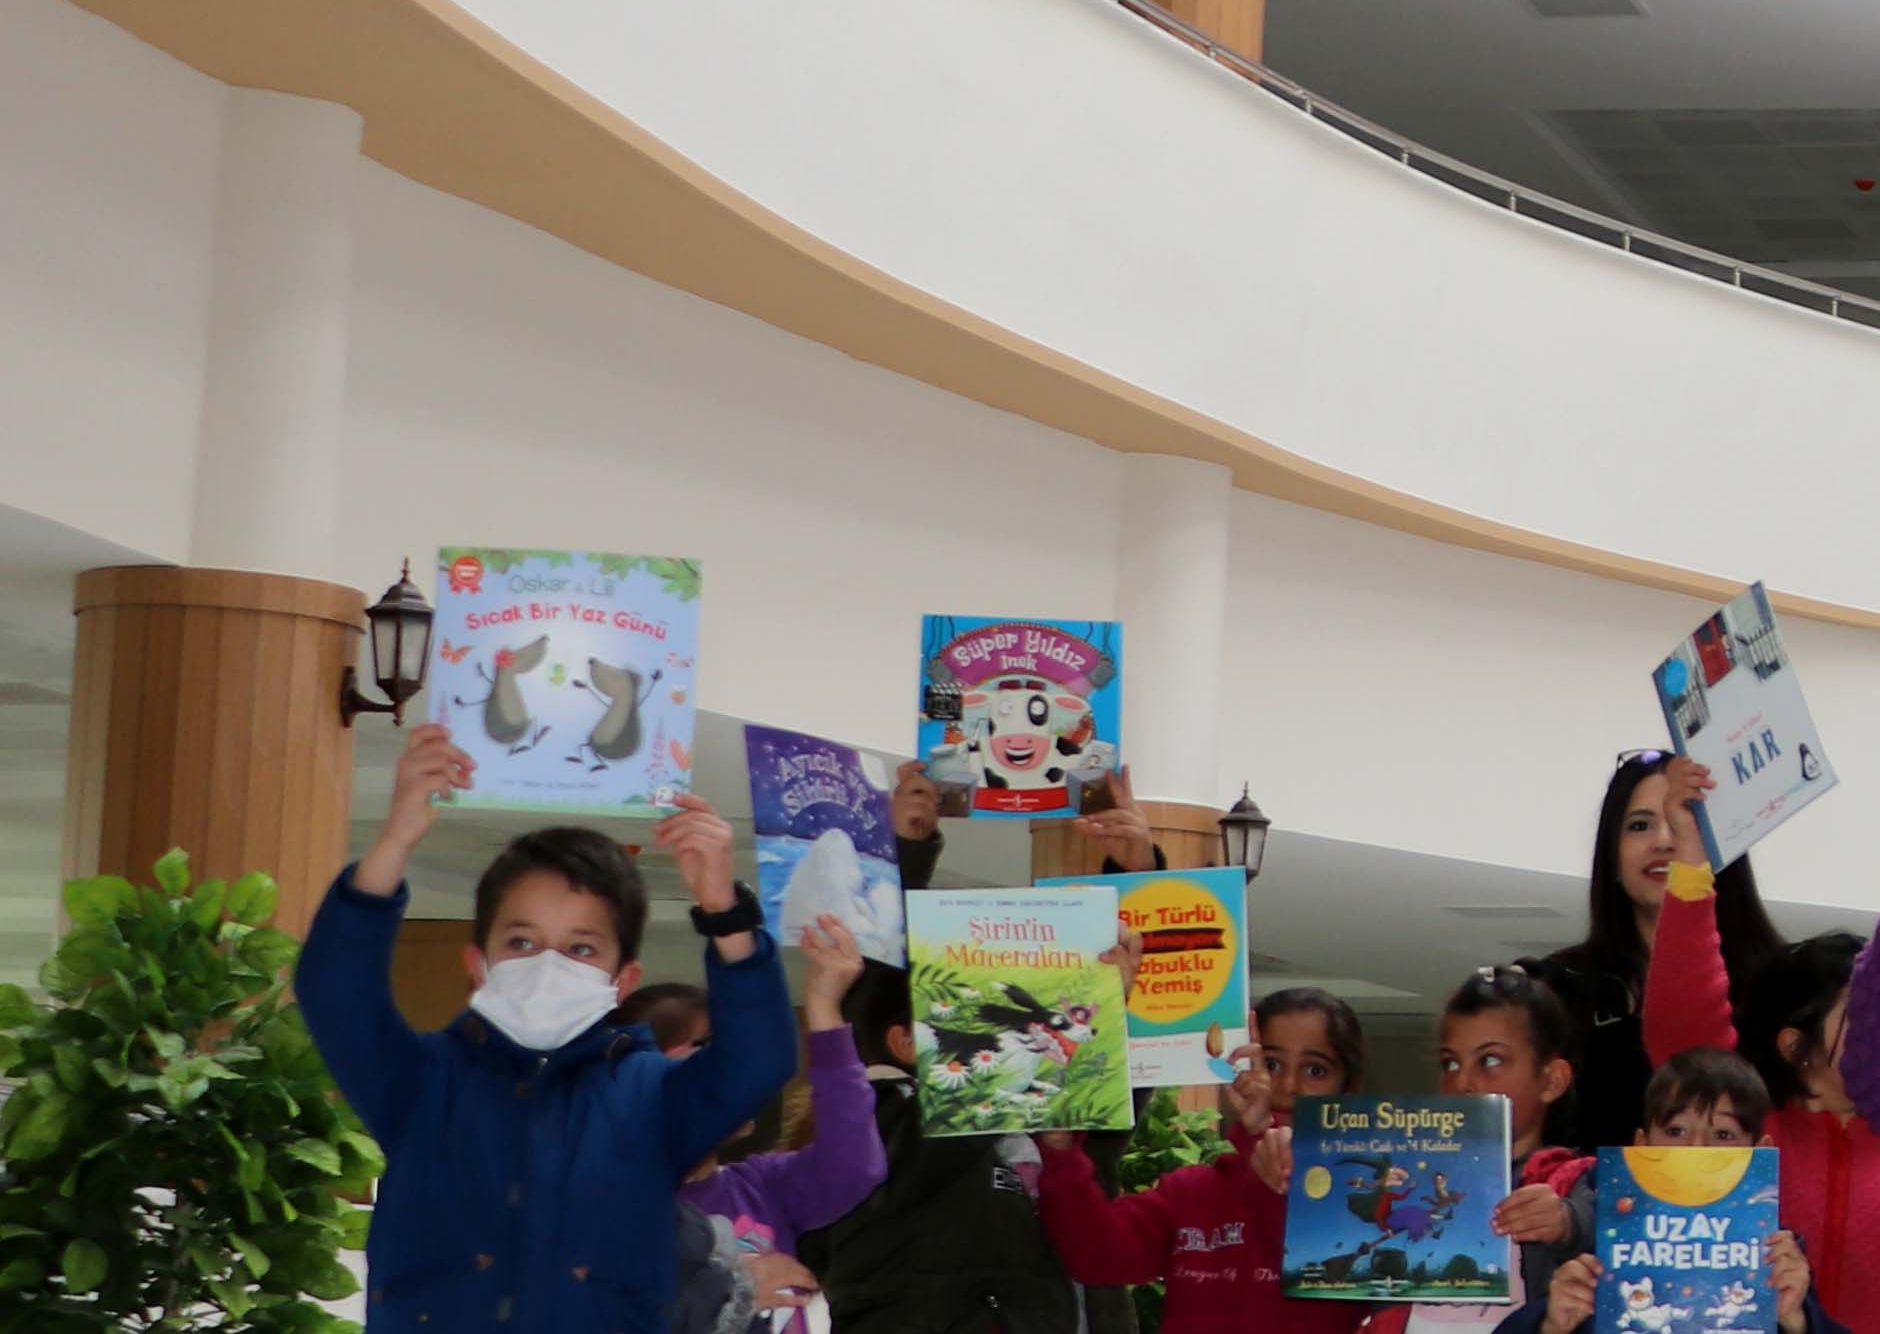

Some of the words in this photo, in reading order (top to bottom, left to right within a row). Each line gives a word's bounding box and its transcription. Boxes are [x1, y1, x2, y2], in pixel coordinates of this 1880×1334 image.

[510, 574, 571, 593] Oskar
[464, 605, 523, 630] Sıcak
[529, 602, 561, 619] Bir
[569, 603, 607, 624] Yaz
[613, 610, 668, 640] Günü
[953, 632, 1019, 667] Süper
[1025, 630, 1087, 670] Yıldız
[1731, 728, 1781, 785] KAR
[1155, 904, 1216, 925] Türlü
[968, 916, 1056, 945] Şirin'in
[945, 943, 1083, 970] Maceraları
[1135, 954, 1214, 975] abuklu
[1135, 974, 1204, 996] Yemiş
[1321, 1104, 1370, 1132] Uçan
[1376, 1102, 1465, 1138] Süpürge
[1645, 1213, 1731, 1242] UZAY
[1612, 1237, 1760, 1270] FARELERİ
